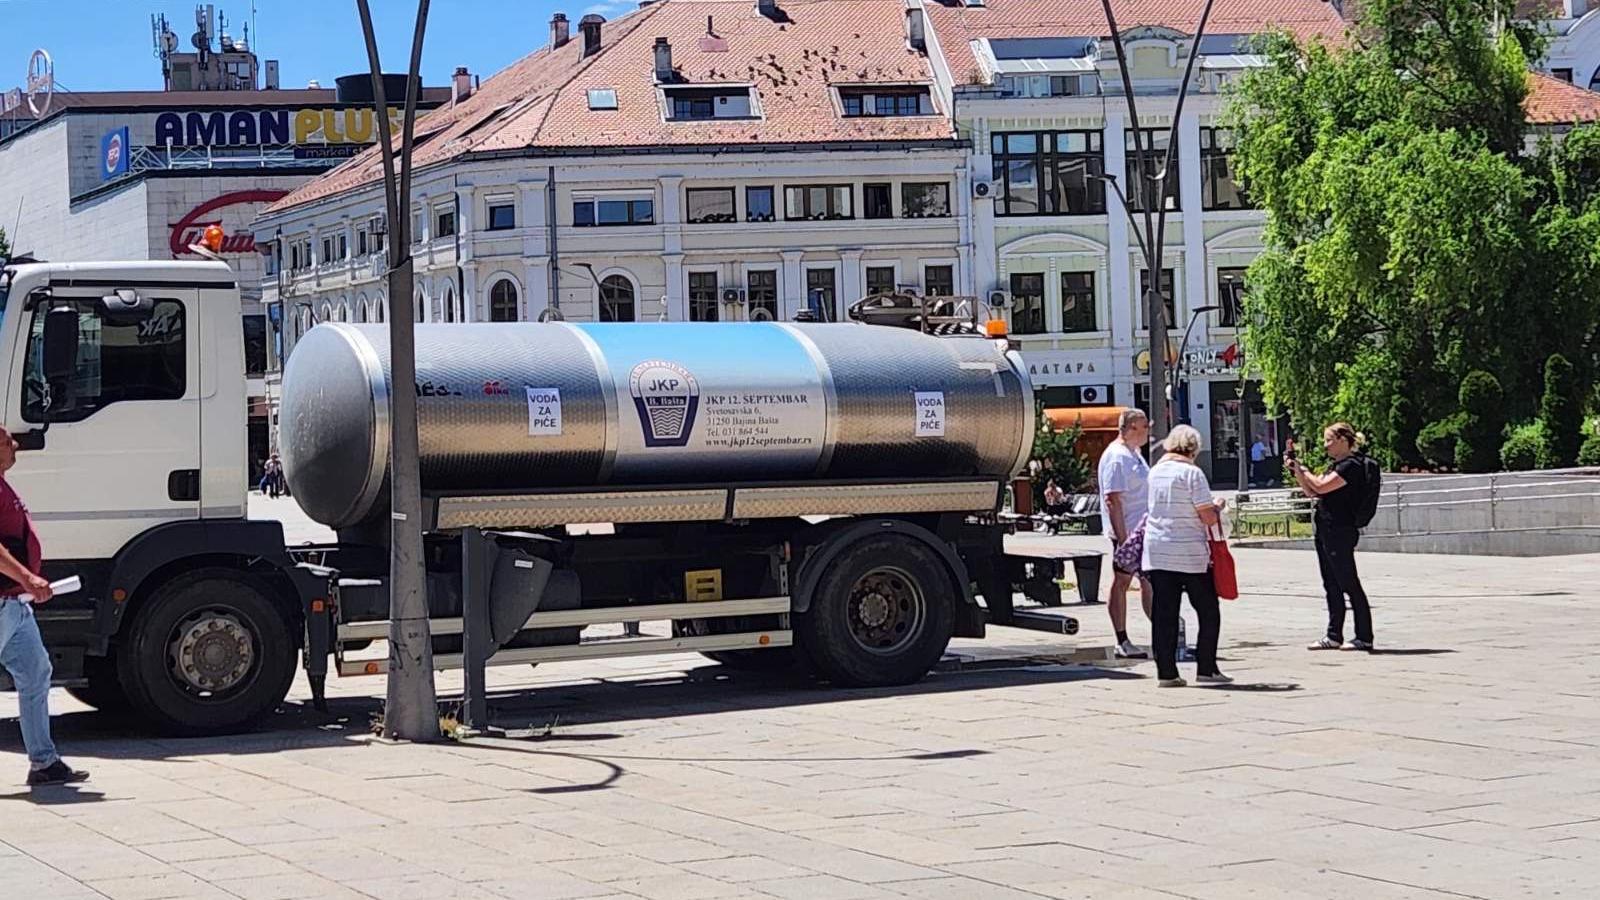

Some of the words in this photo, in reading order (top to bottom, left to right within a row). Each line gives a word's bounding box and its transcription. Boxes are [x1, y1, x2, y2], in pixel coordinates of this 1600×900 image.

[155, 111, 290, 146] AMAN
[649, 379, 679, 391] JKP
[529, 394, 558, 403] VODA
[705, 394, 726, 405] JKP
[917, 397, 942, 407] VODA
[538, 406, 552, 416] ZA
[925, 409, 937, 418] ZA
